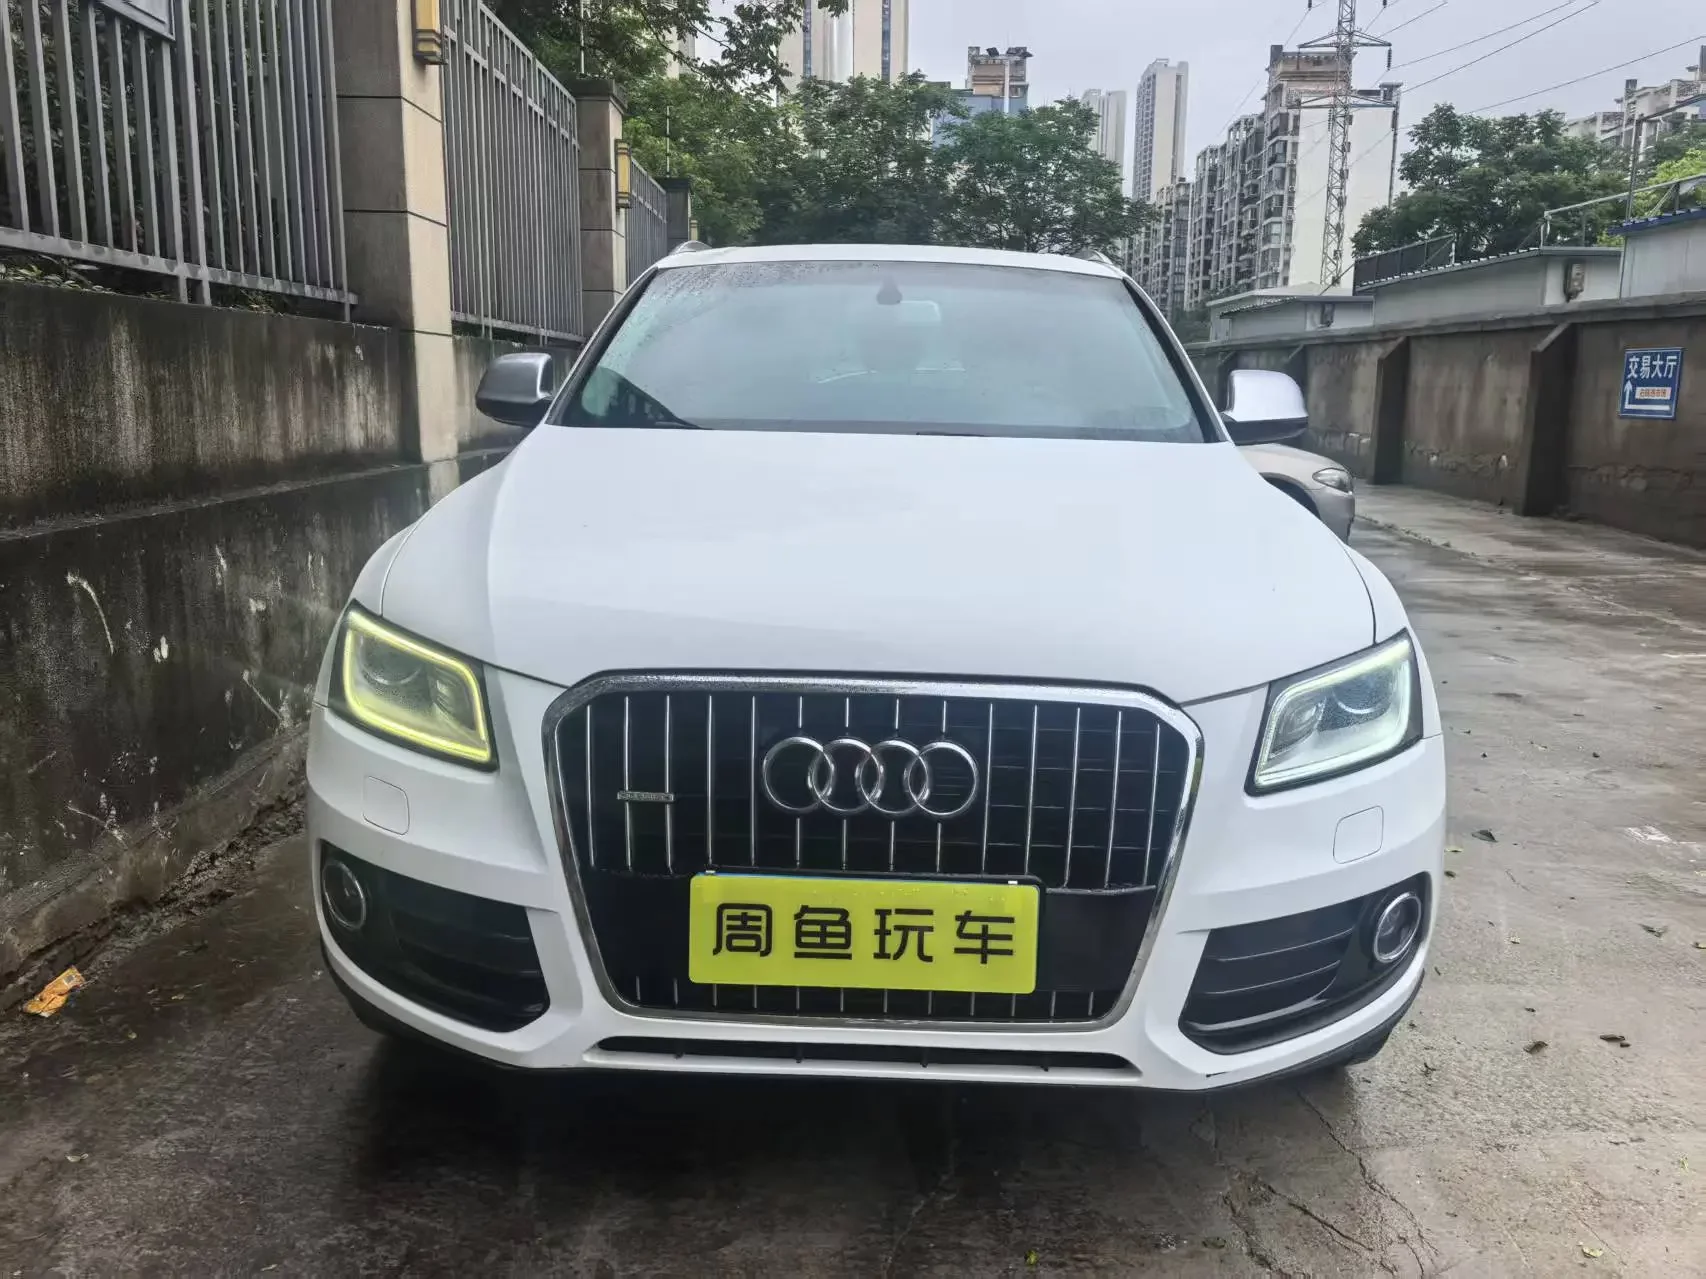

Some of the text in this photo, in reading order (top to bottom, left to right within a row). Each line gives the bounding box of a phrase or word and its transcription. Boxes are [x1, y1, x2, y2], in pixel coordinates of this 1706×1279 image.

[1626, 354, 1677, 379] 交易大厅
[712, 903, 1015, 964] 周鱼玩车
